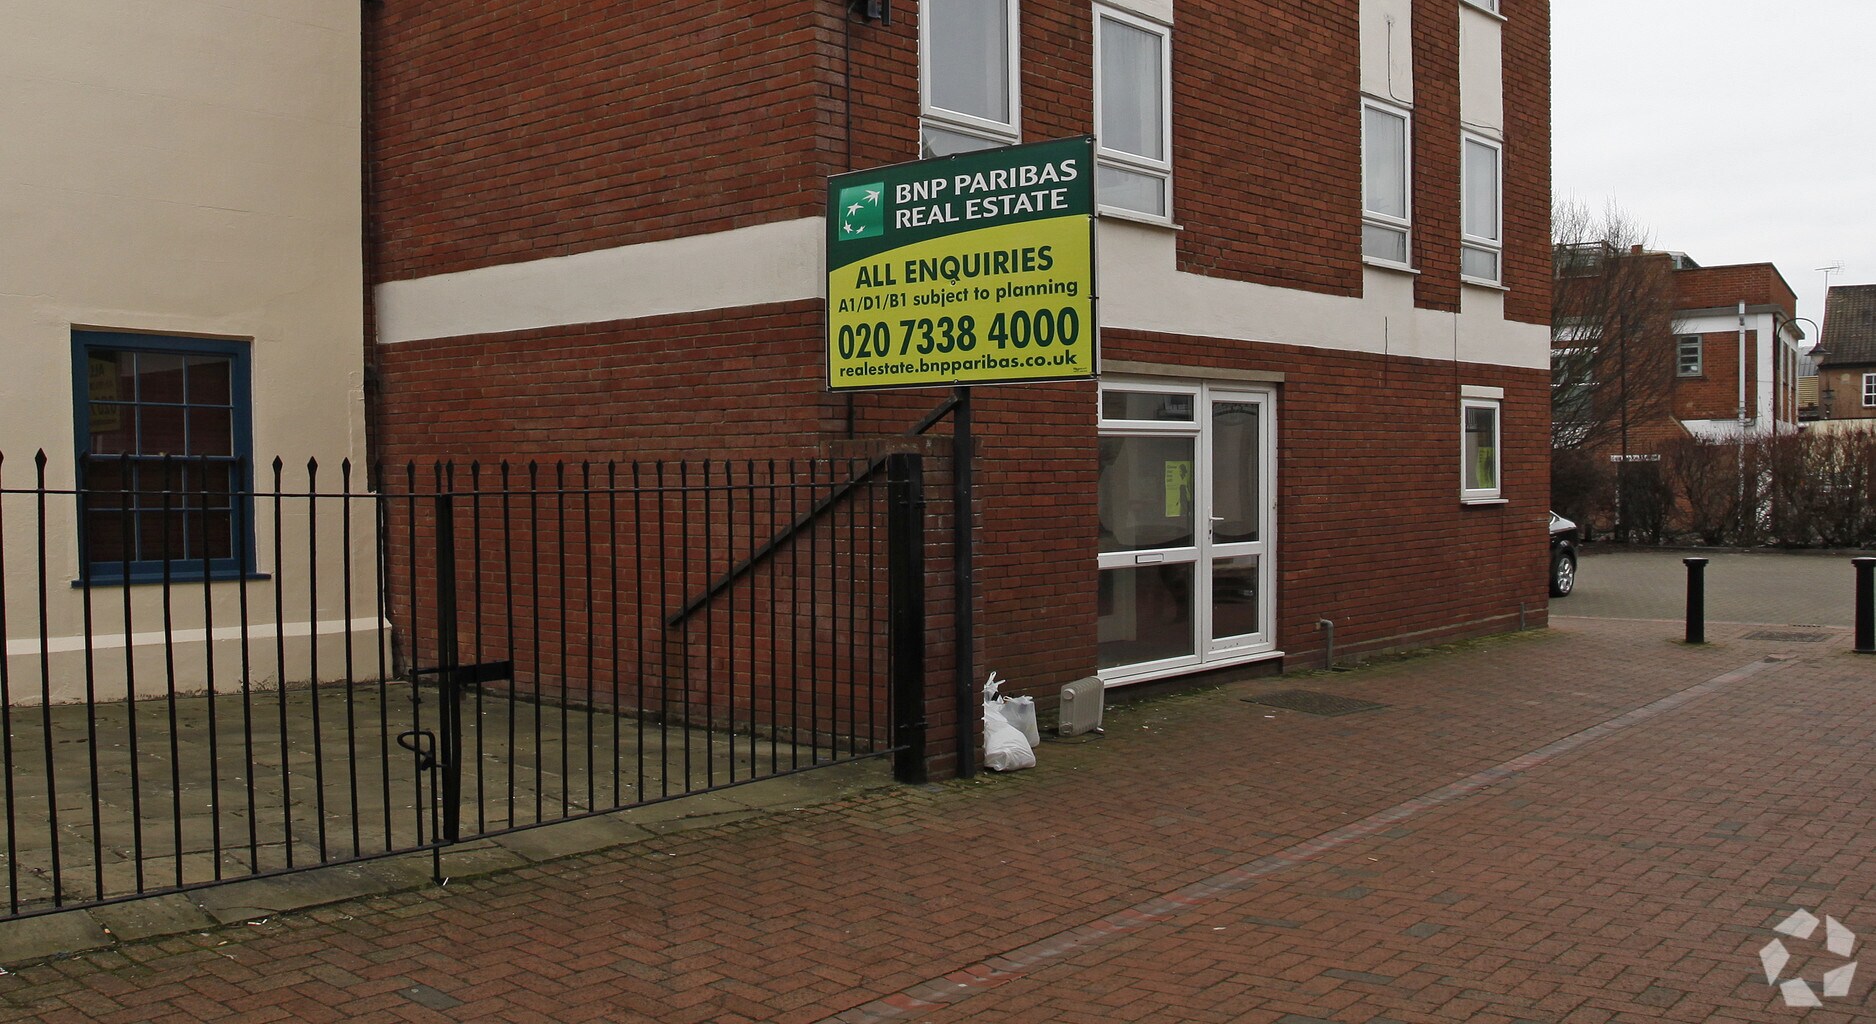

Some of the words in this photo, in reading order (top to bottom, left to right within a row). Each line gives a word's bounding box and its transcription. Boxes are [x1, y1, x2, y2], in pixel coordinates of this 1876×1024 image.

[896, 178, 947, 204] BNP
[954, 159, 1077, 195] PARIBAS
[896, 204, 959, 229] REAL
[966, 188, 1068, 219] ESTATE
[856, 263, 896, 289] ALL
[905, 246, 1053, 284] ENQUIRIES
[839, 293, 906, 313] A1/D1/B1
[913, 288, 968, 308] subject
[974, 286, 990, 300] to
[996, 279, 1078, 302] planning
[839, 322, 890, 359] 020
[900, 315, 976, 356] 7338
[988, 306, 1079, 349] 4000
[840, 350, 1077, 377] realestate.bnpparibas.co.uk
